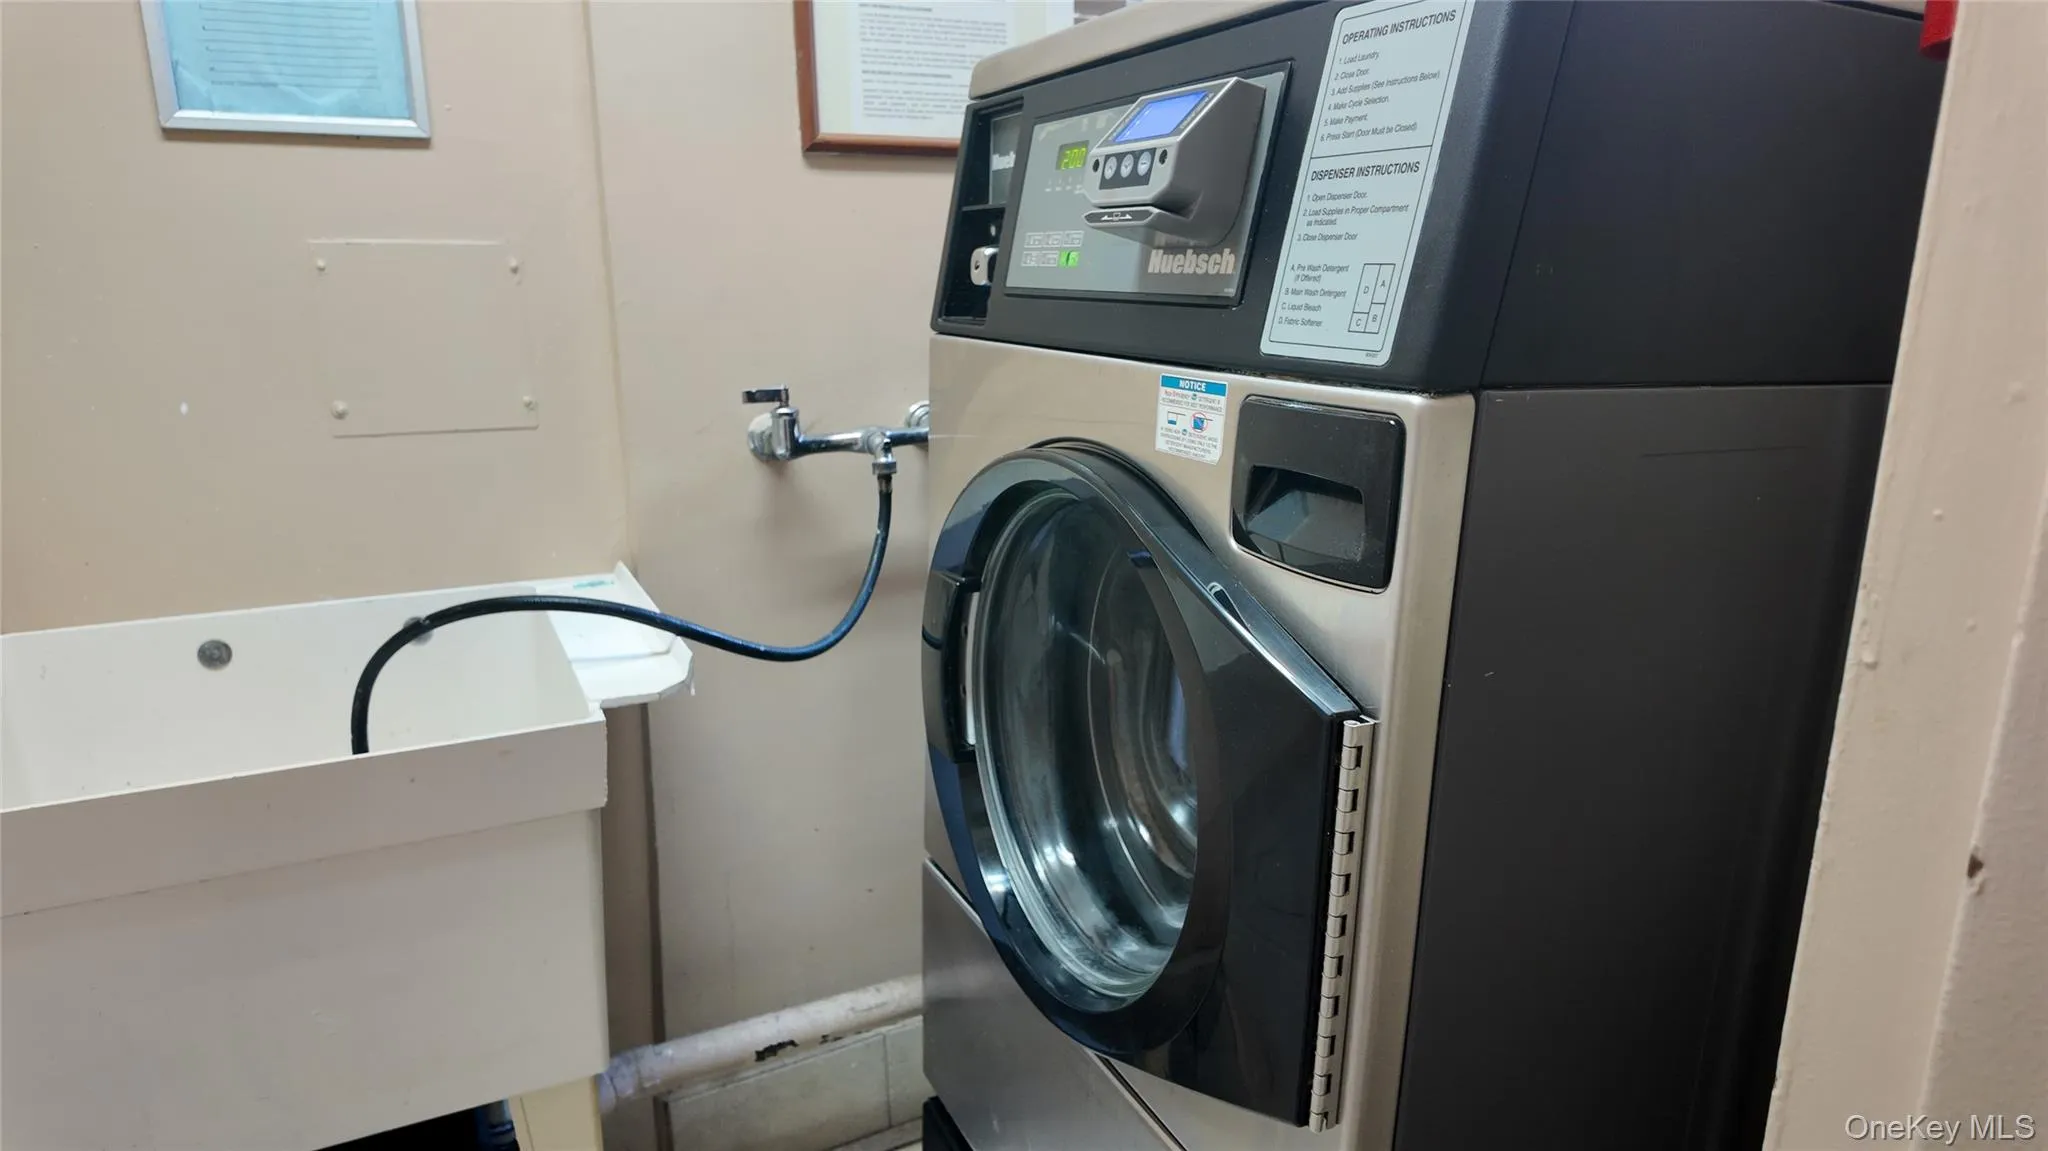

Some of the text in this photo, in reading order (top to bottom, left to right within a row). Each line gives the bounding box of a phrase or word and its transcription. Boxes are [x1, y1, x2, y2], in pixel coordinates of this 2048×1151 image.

[1342, 9, 1457, 45] OPERATING INSTRUCTIONS
[1344, 54, 1357, 65] Load
[1340, 70, 1355, 80] Close
[1336, 85, 1348, 96] Add
[1348, 83, 1371, 95] Supplies
[1371, 80, 1385, 91] (See
[1385, 74, 1419, 88] Instructions
[1333, 101, 1348, 111] Make
[1348, 99, 1362, 110] Cycle
[1329, 117, 1344, 126] Make
[1325, 132, 1341, 142] Press
[1341, 130, 1355, 140] Start
[1355, 128, 1371, 139] (Door
[1371, 127, 1386, 137] Must
[1386, 125, 1394, 135] be
[1310, 161, 1420, 181] DISPENSER INSTRUCTIONS
[1311, 193, 1326, 203] Open
[1326, 191, 1353, 202] Dispenser
[1309, 207, 1321, 217] Load
[1321, 206, 1344, 218] Supplies
[1350, 205, 1370, 216] Proper
[1369, 203, 1410, 215] Compartment
[1302, 232, 1318, 242] Close
[1317, 232, 1344, 243] Dispenser
[1147, 247, 1236, 275] Huebsch
[1296, 263, 1306, 272] Pre
[1307, 263, 1321, 272] Wash
[1321, 263, 1350, 275] Detergent
[1380, 279, 1386, 288] A
[1290, 287, 1304, 296] Main
[1303, 288, 1319, 297] Wash
[1319, 287, 1347, 299] Detergent
[1363, 285, 1370, 295] D
[1287, 302, 1303, 312] Liquid
[1303, 302, 1322, 313] Bleach
[1283, 316, 1299, 326] Fabric
[1355, 318, 1362, 327] C
[1371, 313, 1379, 323] B
[1179, 379, 1207, 392] NOTICE
